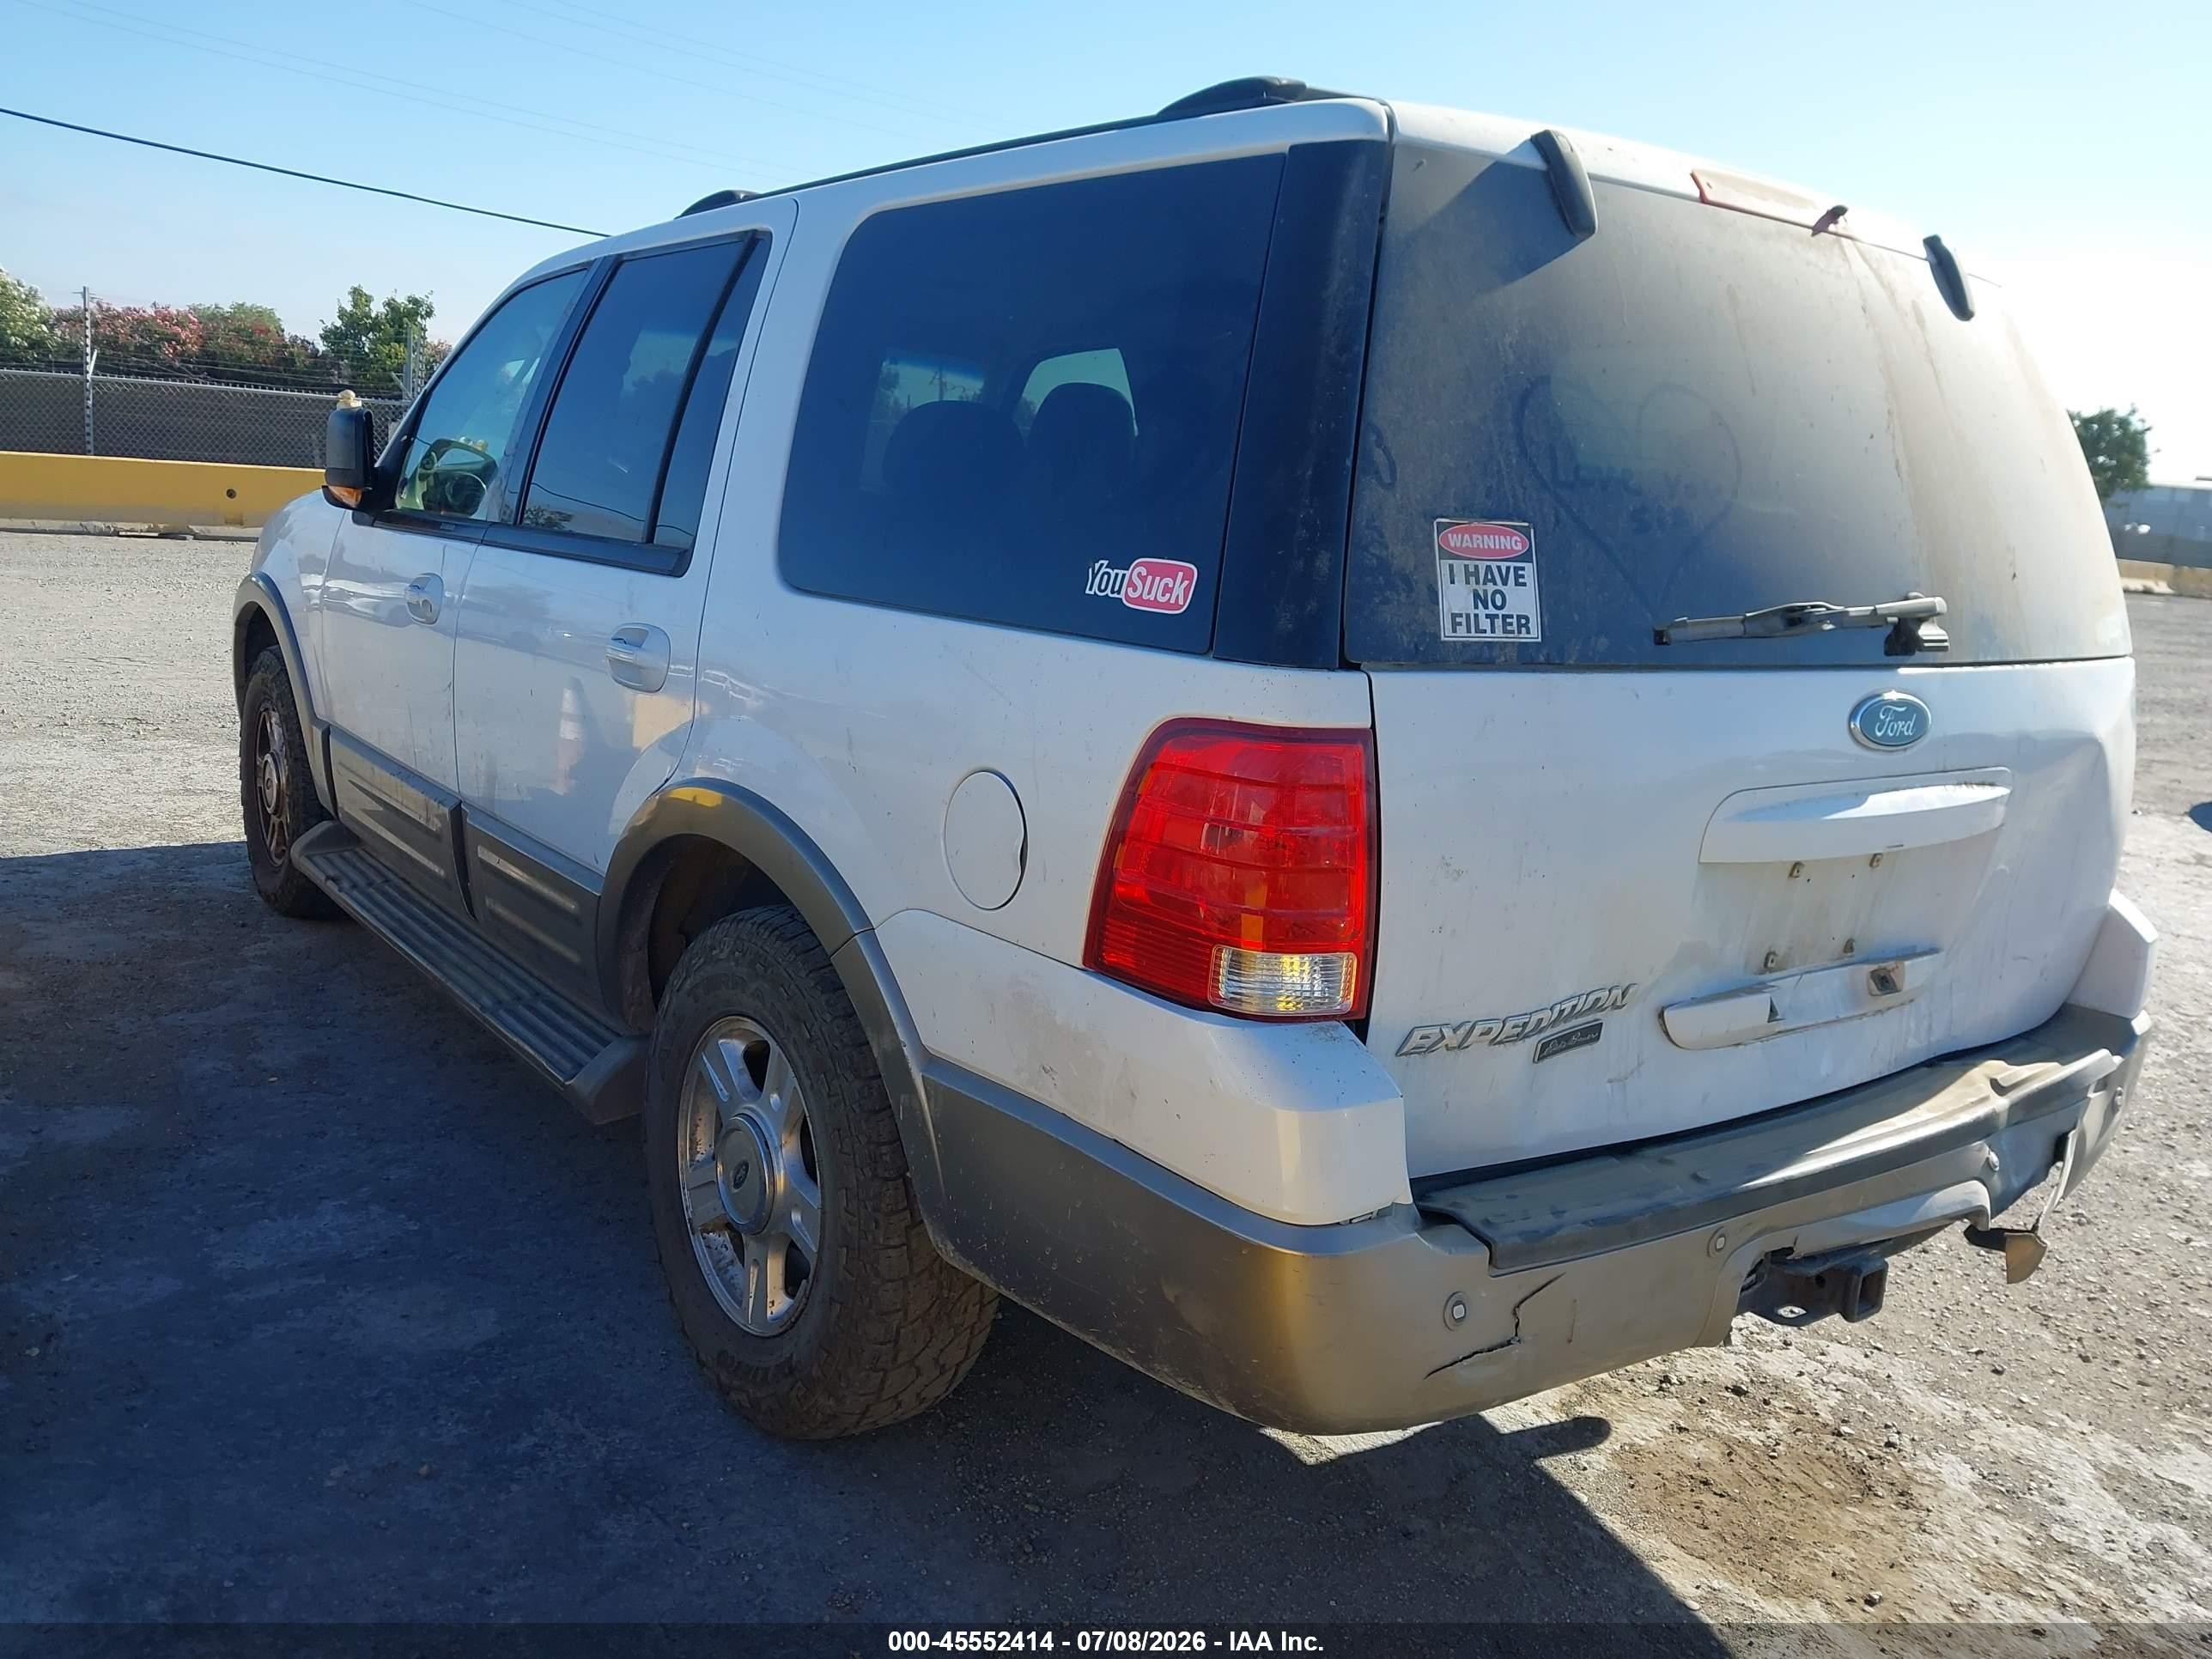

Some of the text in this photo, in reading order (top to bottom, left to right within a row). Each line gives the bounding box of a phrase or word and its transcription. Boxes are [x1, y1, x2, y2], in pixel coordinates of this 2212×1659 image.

[1448, 533, 1522, 550] WARNING
[1448, 563, 1527, 587] I HAVE
[1473, 588, 1507, 611] NO
[1450, 612, 1531, 635] FILTER
[1875, 705, 1917, 737] Ford
[1395, 983, 1638, 1057] EXPEDITION
